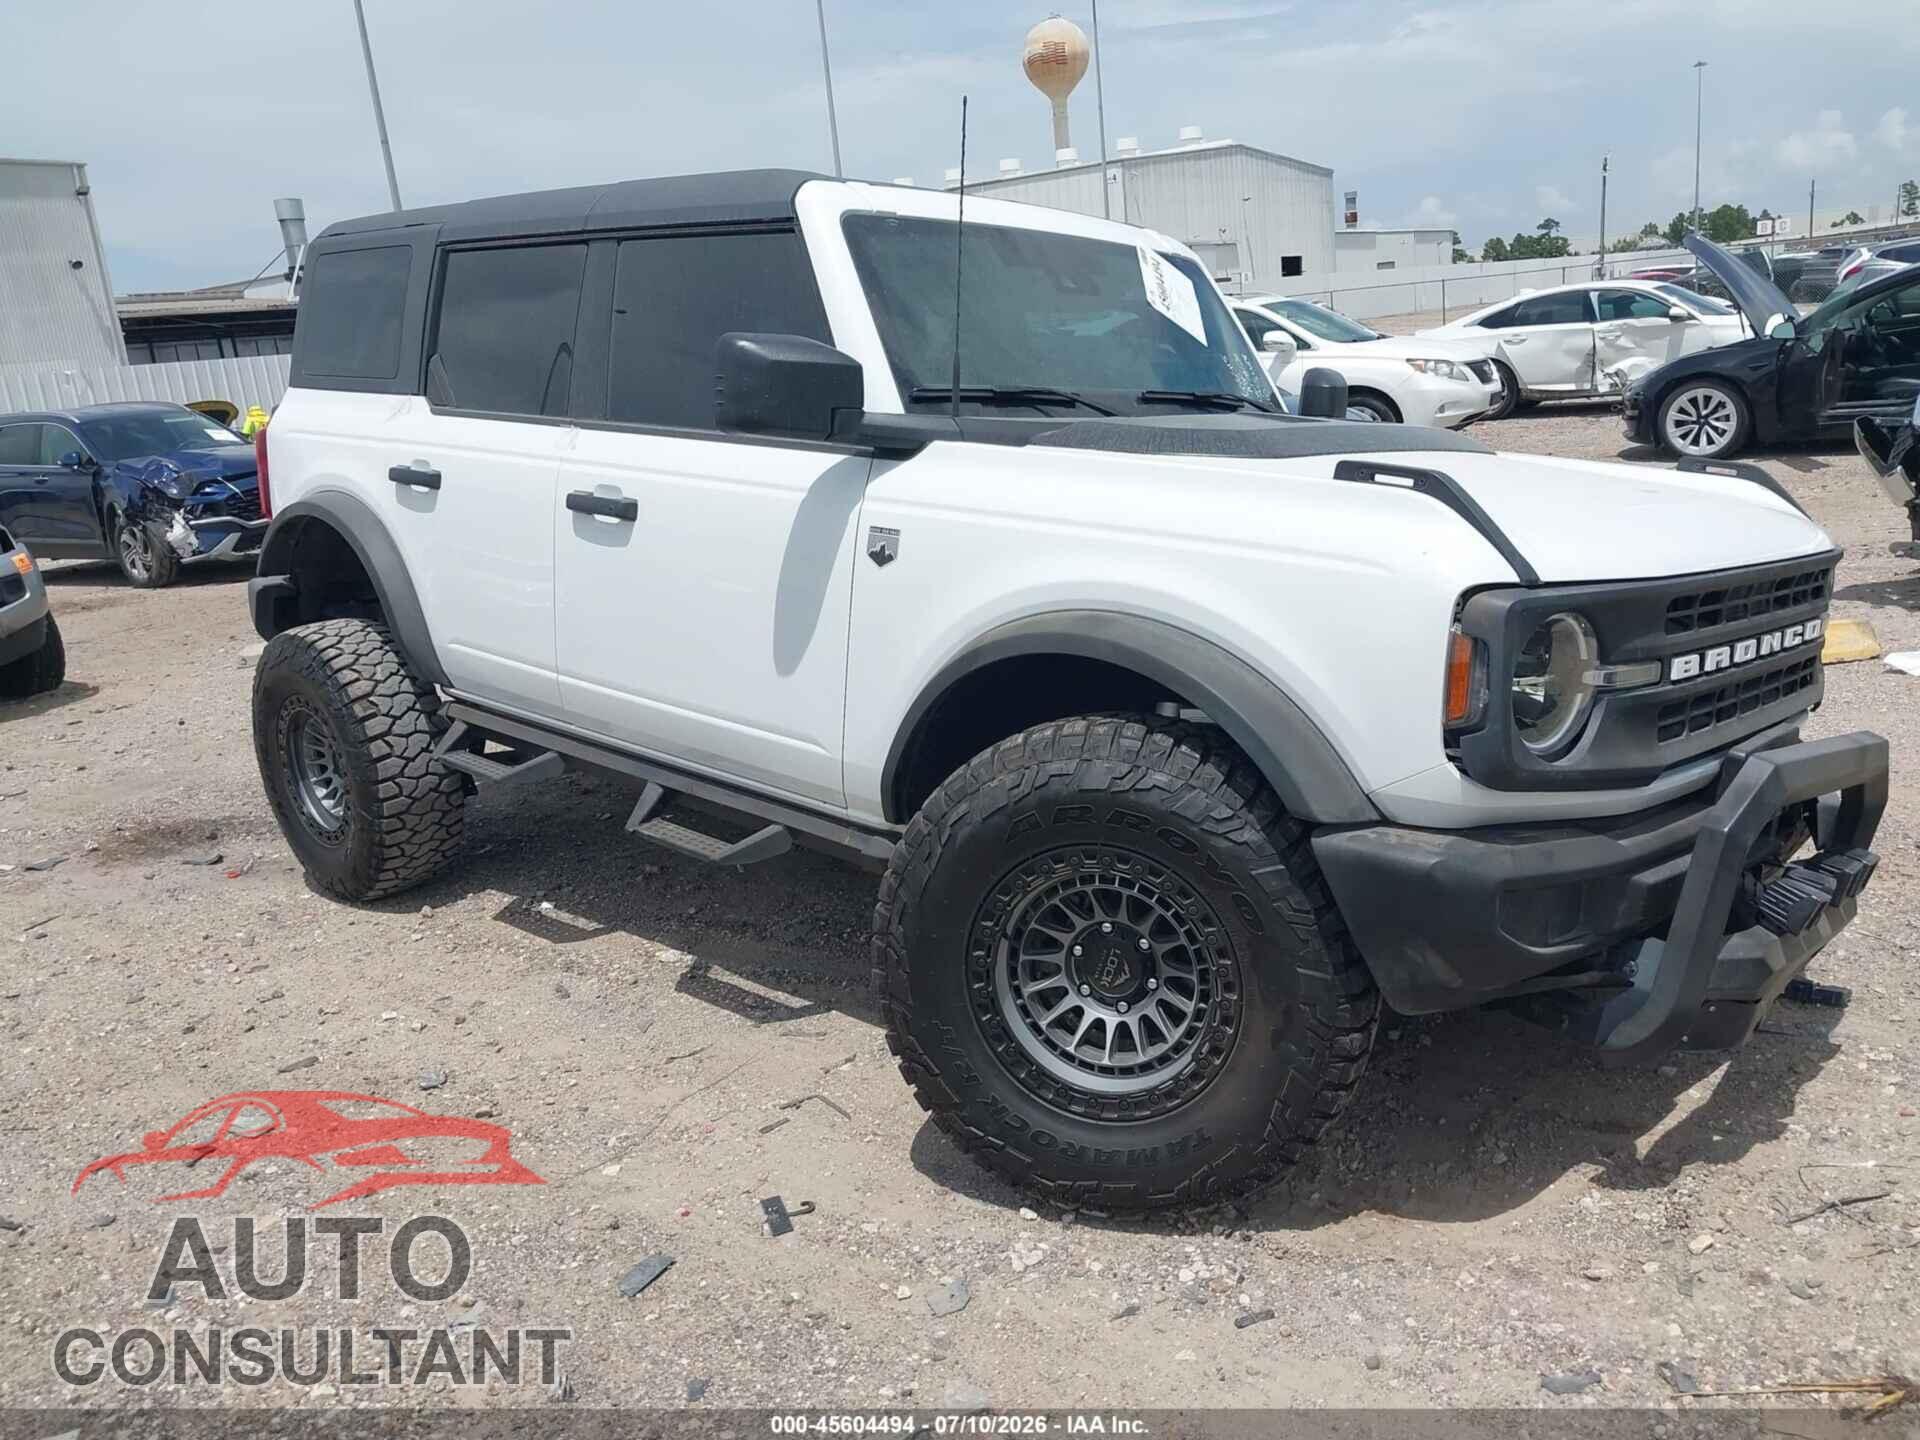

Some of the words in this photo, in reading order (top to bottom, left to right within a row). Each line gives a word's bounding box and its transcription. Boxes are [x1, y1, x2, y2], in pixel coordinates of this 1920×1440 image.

[1670, 619, 1824, 681] BRONCO
[1005, 804, 1265, 935] ARROYO
[977, 1092, 1213, 1168] TAMAROCK
